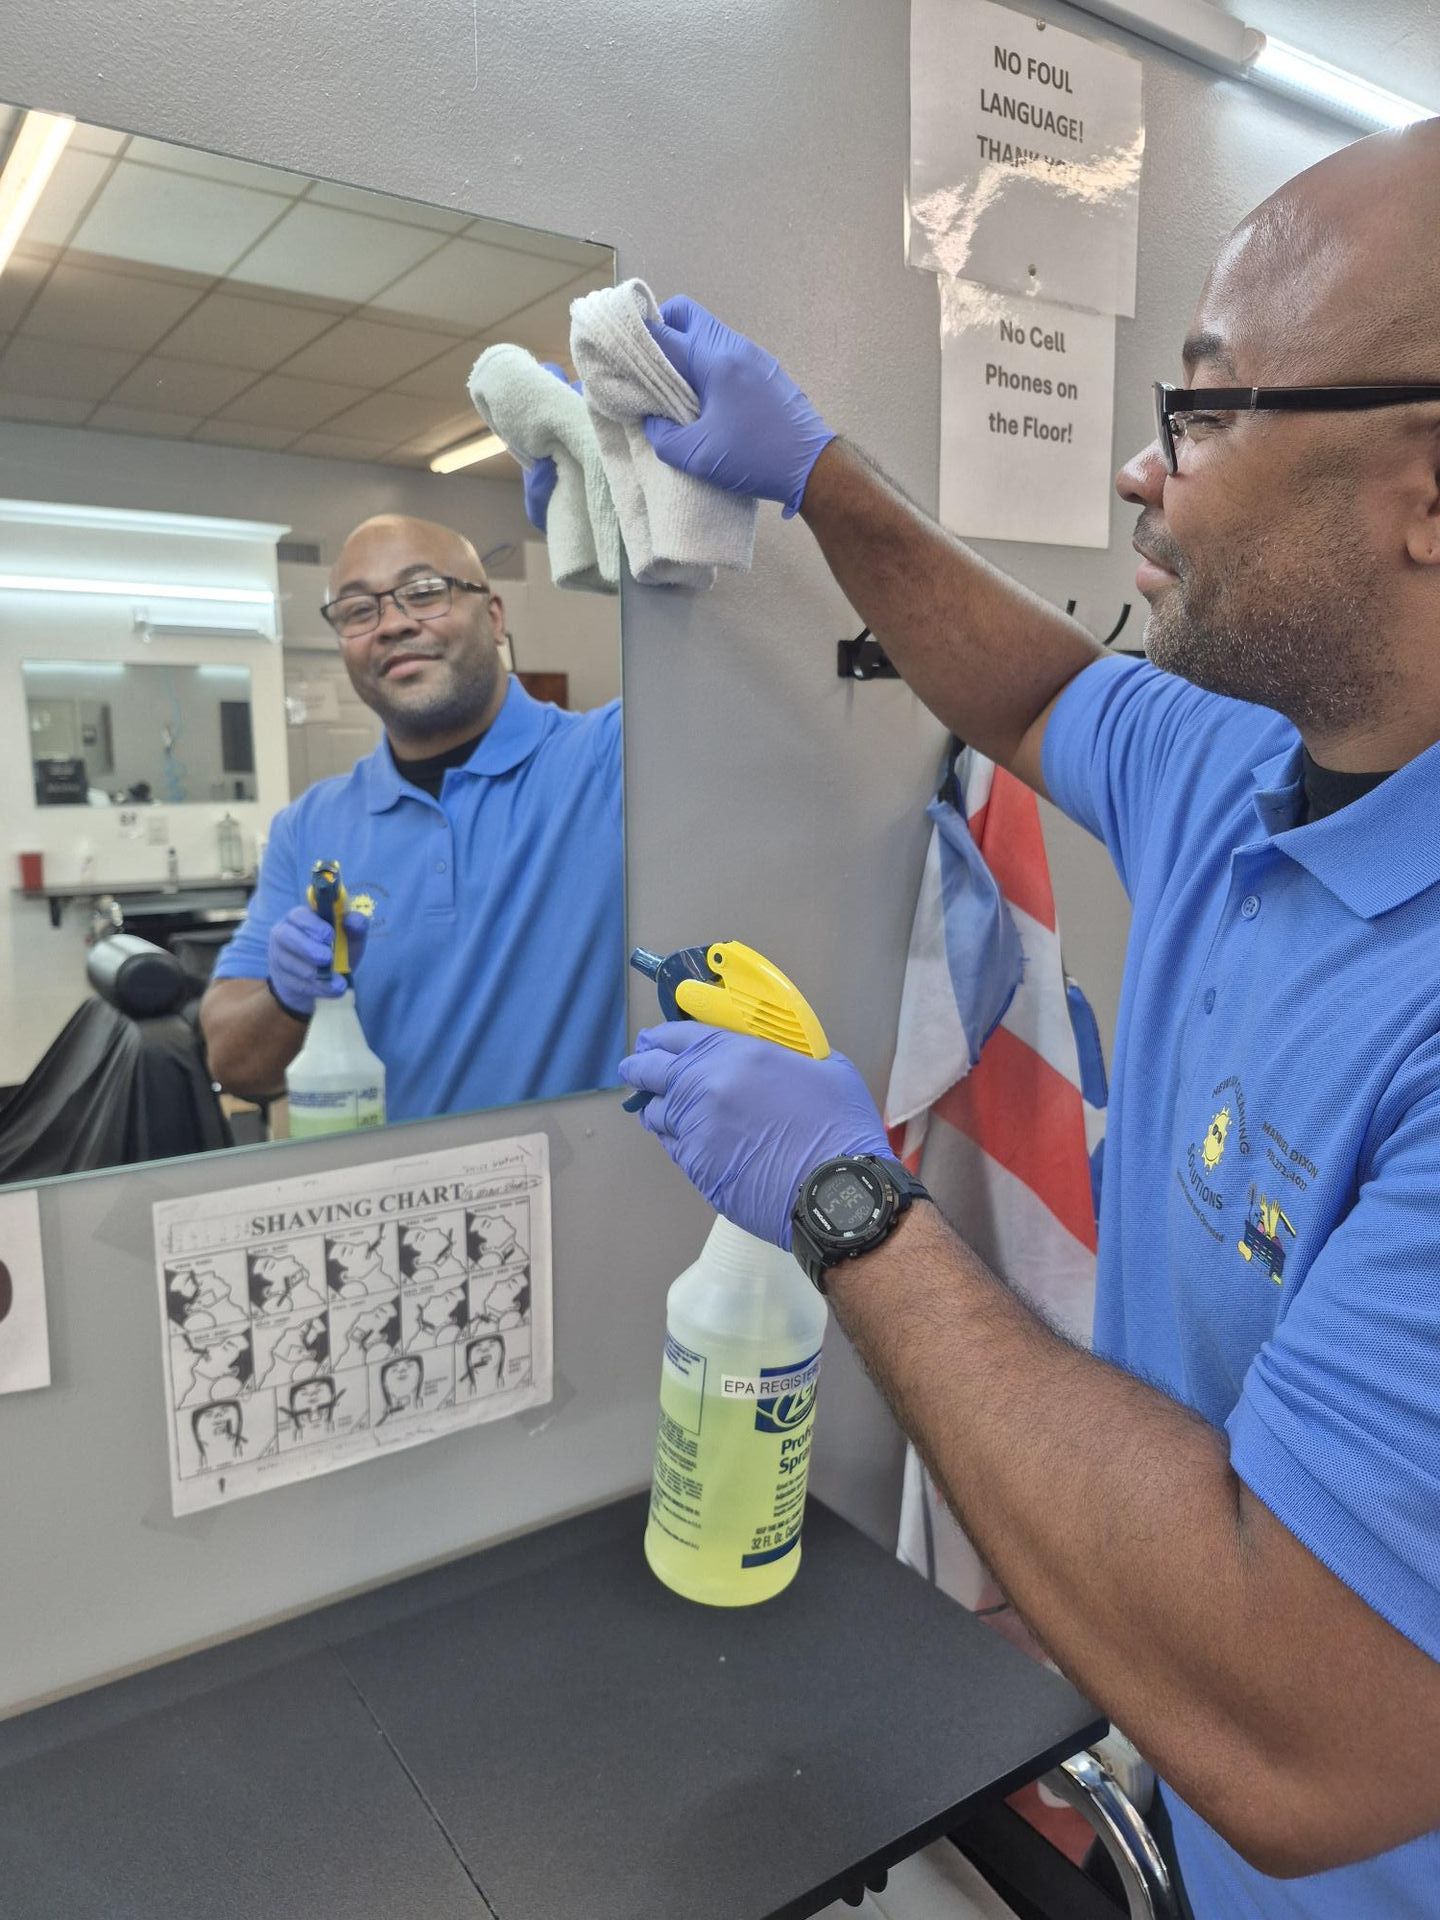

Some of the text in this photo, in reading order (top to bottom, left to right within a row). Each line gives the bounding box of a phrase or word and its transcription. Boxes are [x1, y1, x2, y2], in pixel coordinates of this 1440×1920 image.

[994, 45, 1073, 94] NO FOUL
[981, 88, 1083, 143] LANGUAGE!
[1000, 319, 1066, 353] No Cell
[985, 363, 1078, 400] Phones on
[989, 411, 1073, 443] the Floor!
[1187, 1142, 1223, 1210] SOLUTIONS
[1289, 1148, 1318, 1179] DIXON
[252, 1199, 372, 1236] SHAVING
[379, 1182, 466, 1214] CHART
[724, 1380, 755, 1394] EPA
